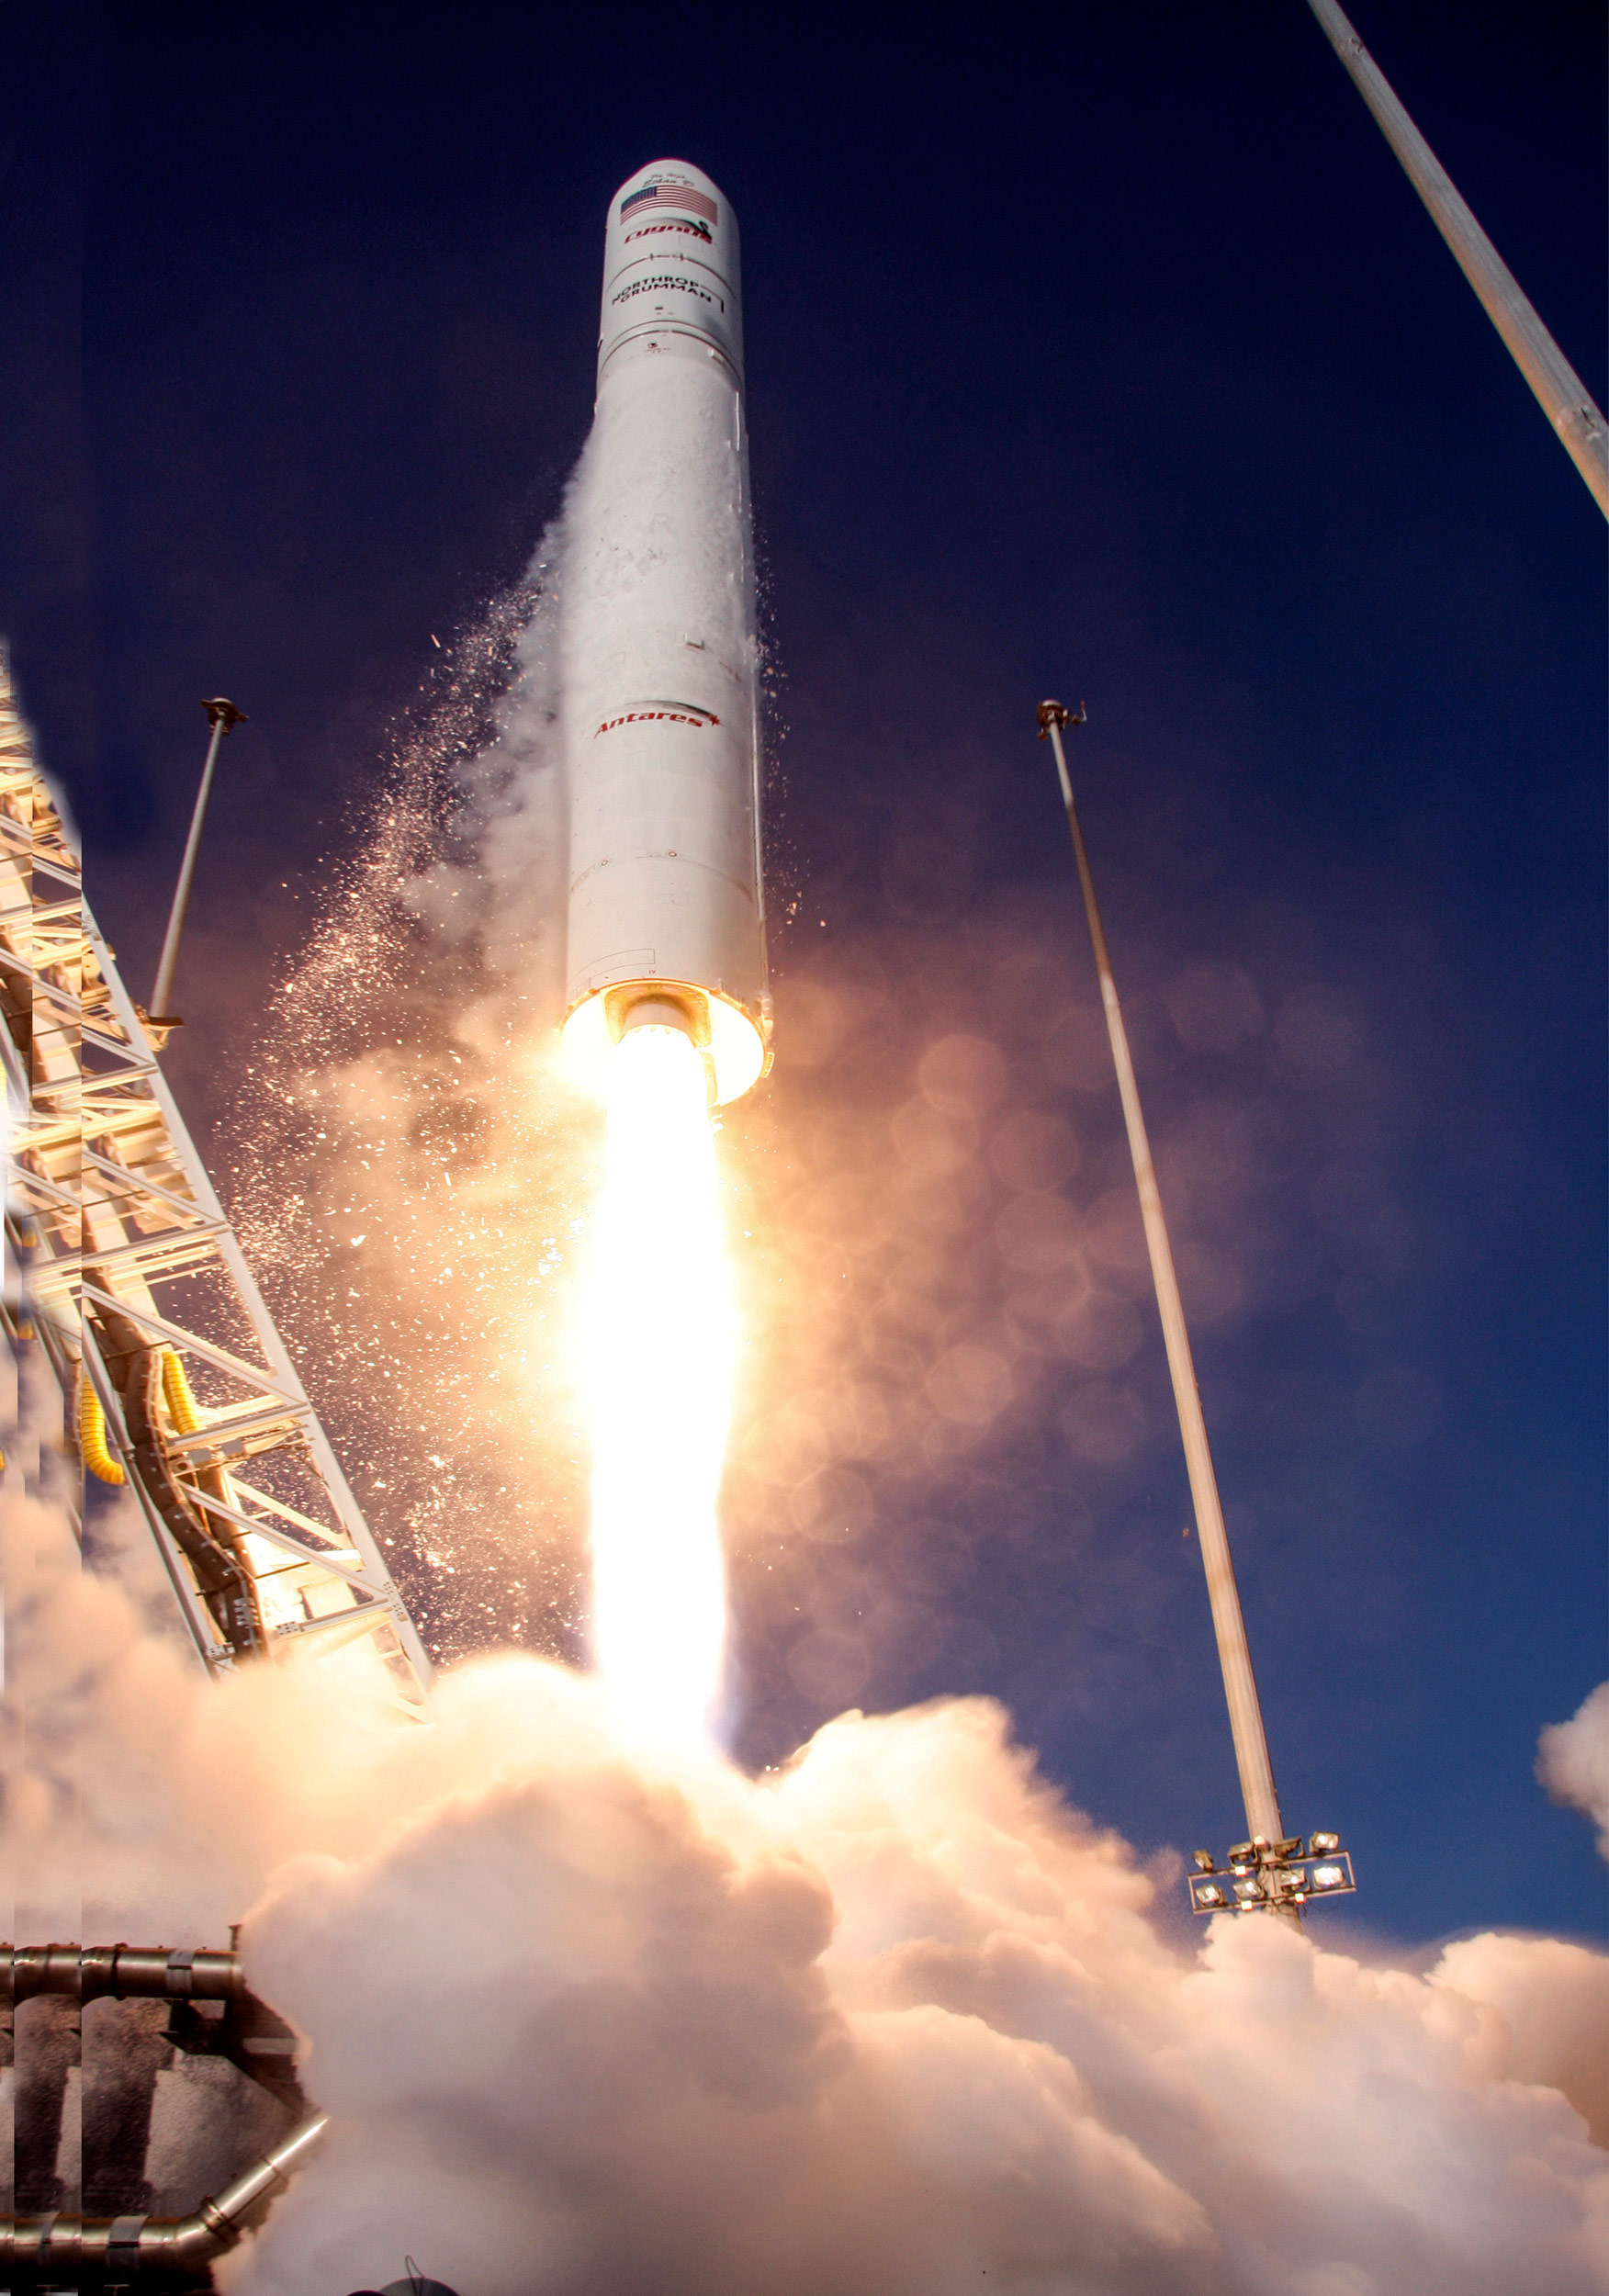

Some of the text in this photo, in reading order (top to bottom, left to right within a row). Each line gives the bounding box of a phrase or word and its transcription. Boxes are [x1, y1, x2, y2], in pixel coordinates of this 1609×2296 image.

[612, 276, 700, 305] NORTHROP
[621, 284, 712, 303] GRUMMAN
[594, 712, 703, 738] Antares
